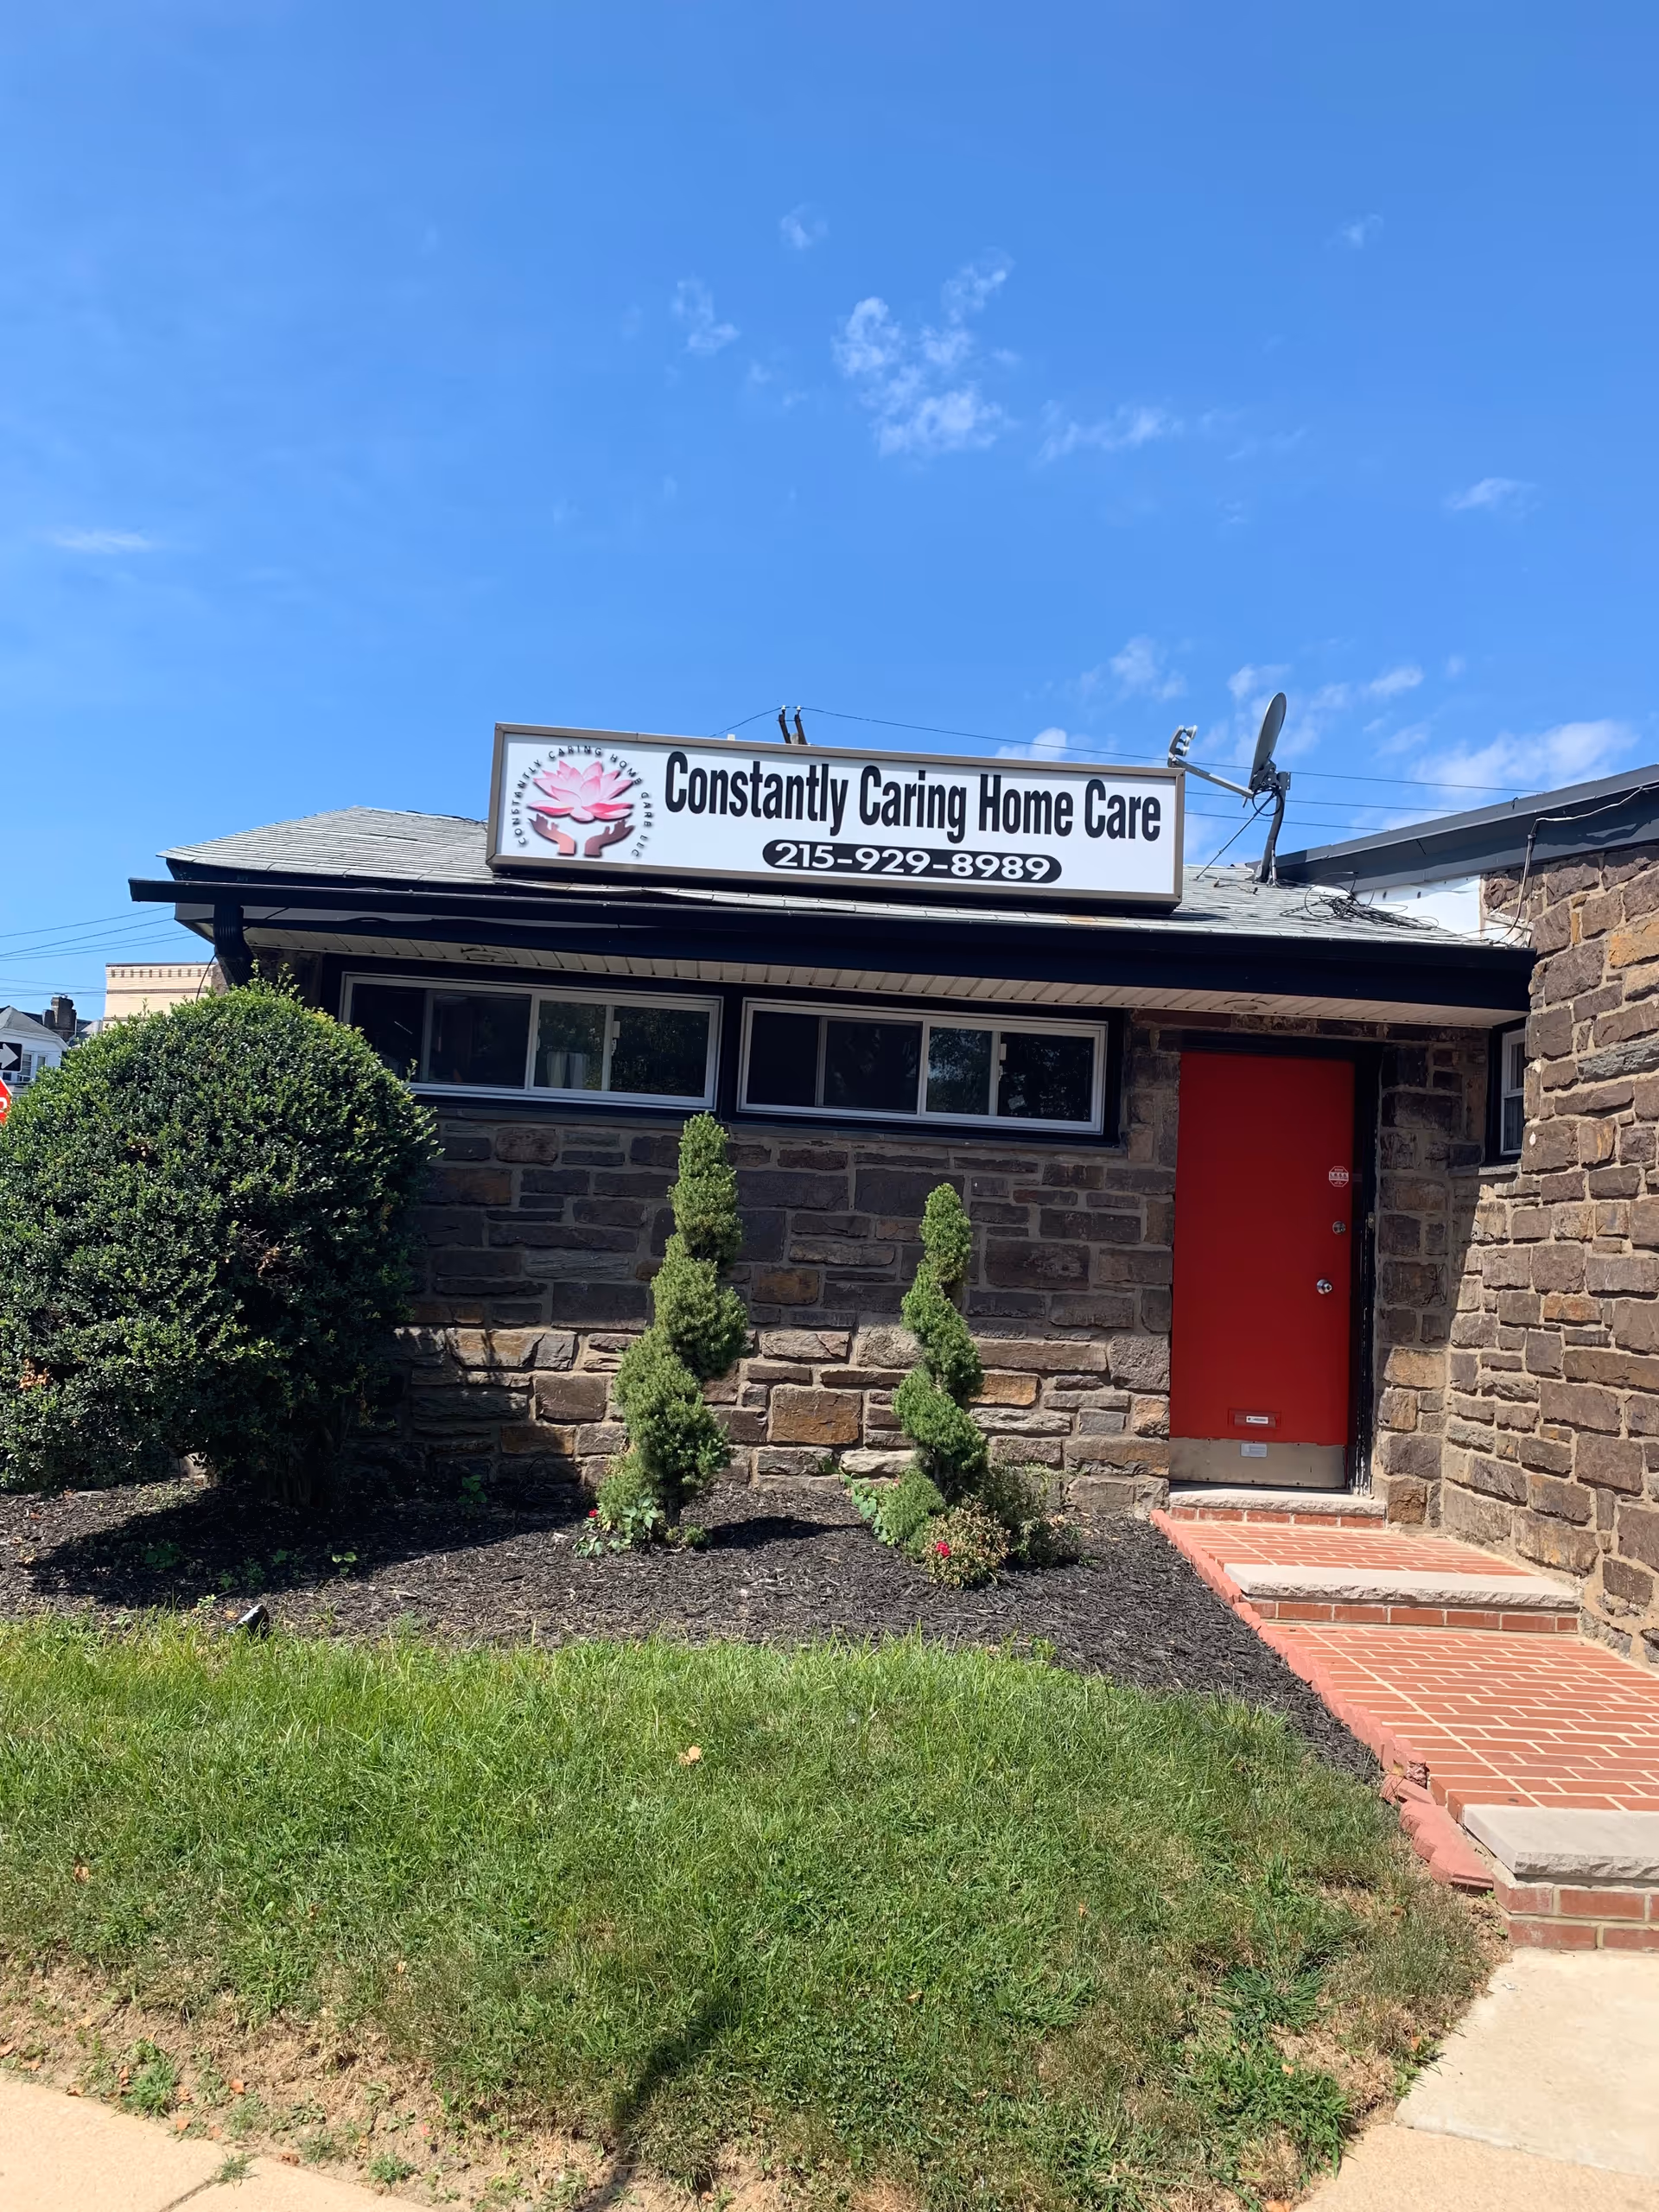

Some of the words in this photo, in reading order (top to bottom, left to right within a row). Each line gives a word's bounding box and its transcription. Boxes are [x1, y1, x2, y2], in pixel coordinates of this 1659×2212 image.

[512, 760, 542, 846] CONSTANTLY
[549, 745, 602, 760] CARING
[665, 751, 849, 836] Constantly
[860, 765, 967, 843] Caring
[979, 774, 1073, 837] Home
[1084, 779, 1160, 842] Care
[774, 842, 1050, 880] 215-929-8989
